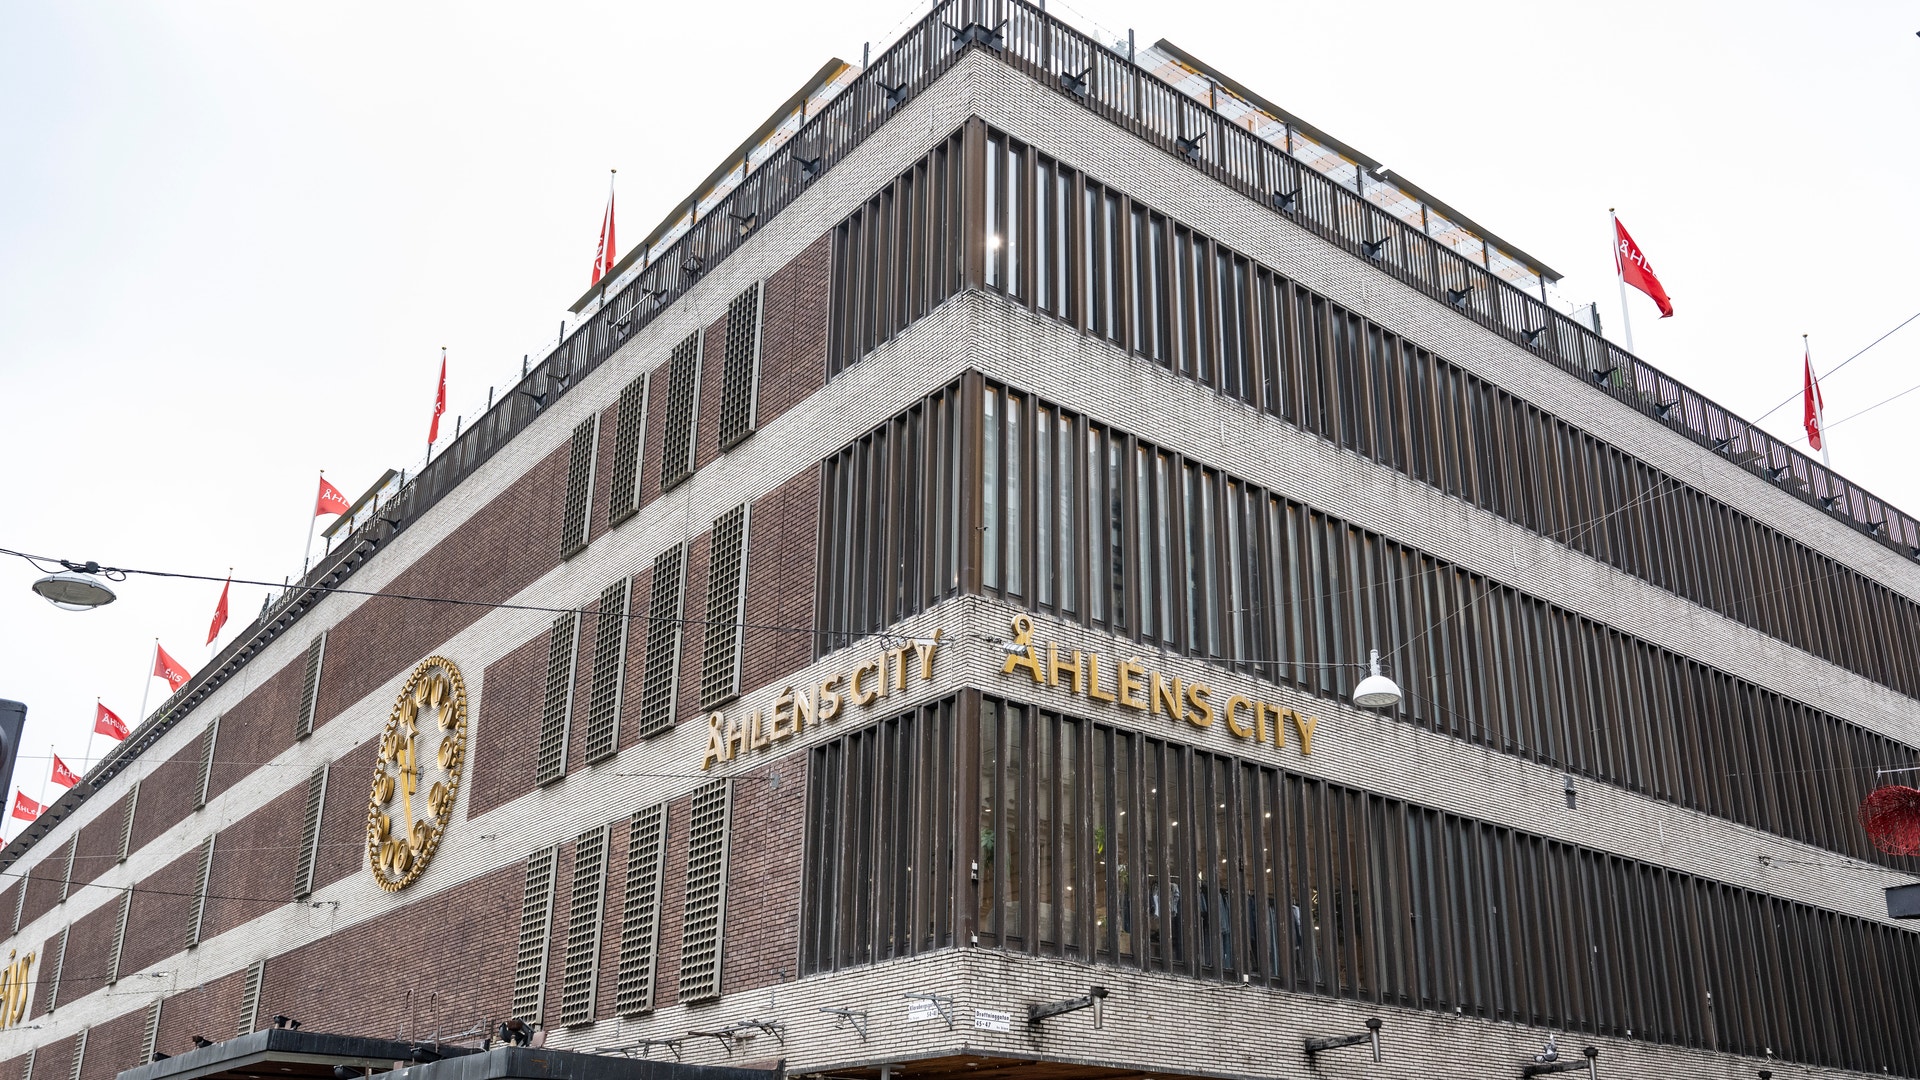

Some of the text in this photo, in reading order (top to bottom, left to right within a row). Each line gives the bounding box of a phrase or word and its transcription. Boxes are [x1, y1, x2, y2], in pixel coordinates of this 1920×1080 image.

[1620, 240, 1655, 276] ÅHL
[701, 628, 943, 771] ÅHLÉNS CITY
[1002, 613, 1320, 755] ÅHLÉNS CITY
